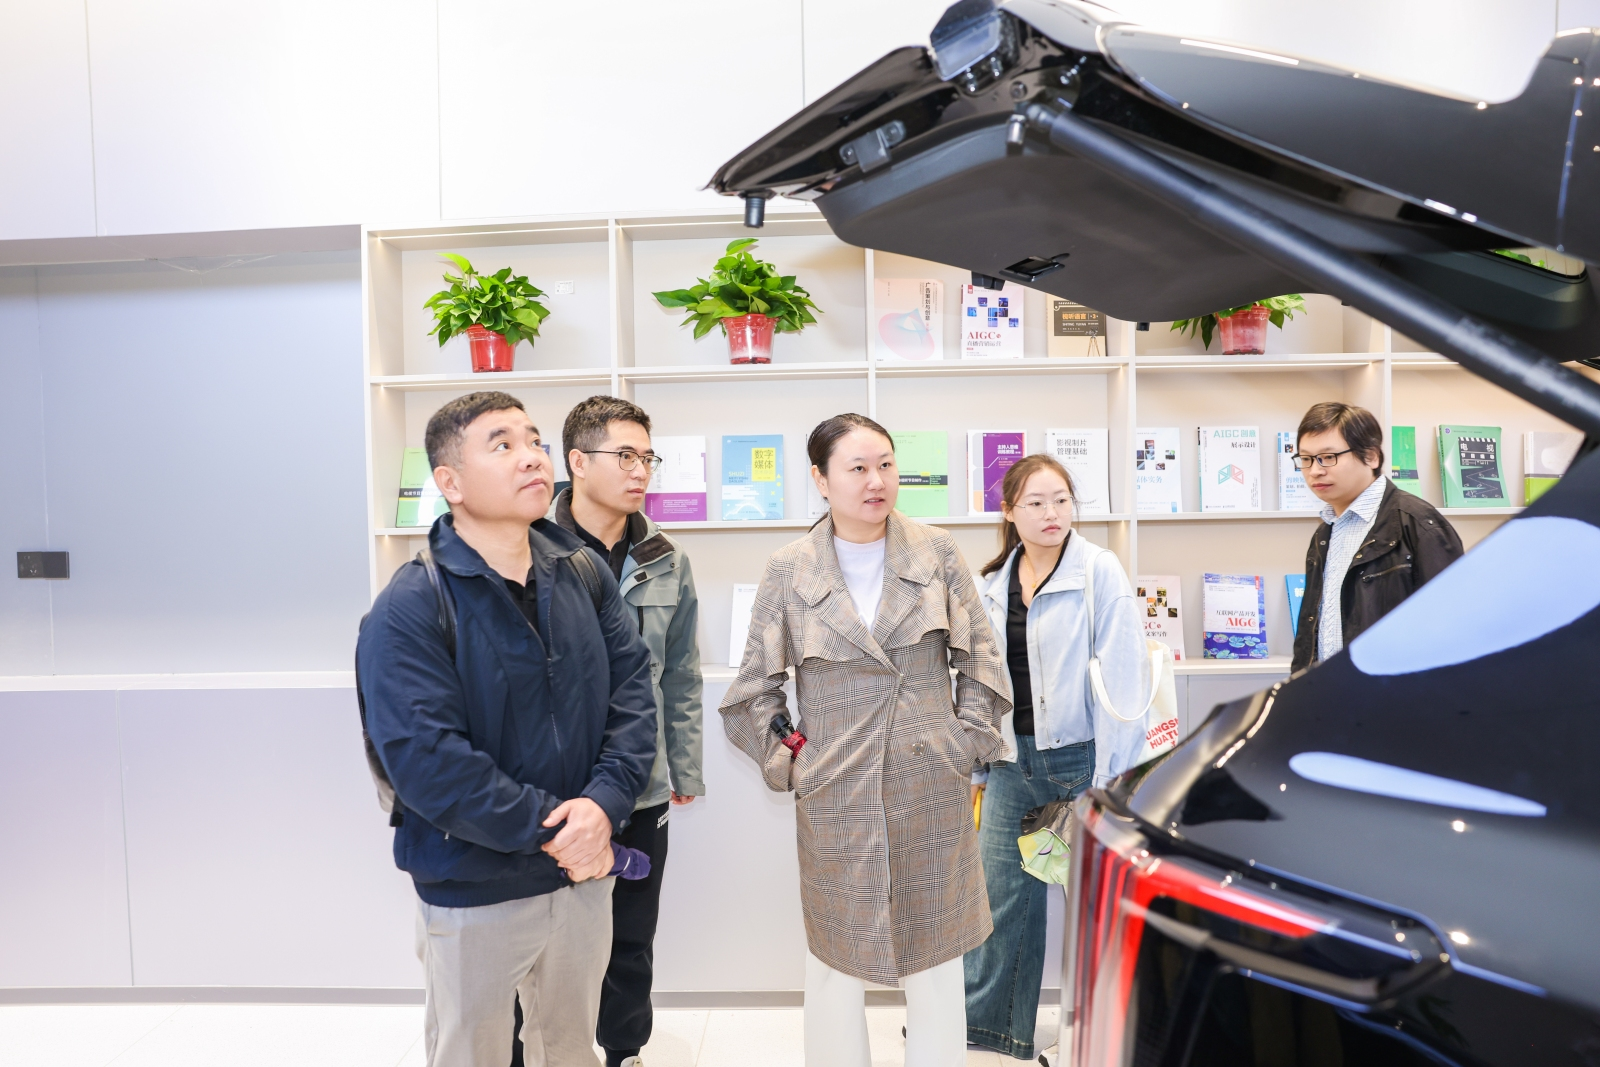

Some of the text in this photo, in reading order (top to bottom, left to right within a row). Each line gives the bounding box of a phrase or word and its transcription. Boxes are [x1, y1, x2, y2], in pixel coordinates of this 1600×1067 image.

[967, 331, 996, 340] AIGC
[1056, 438, 1087, 447] 影视制片
[1460, 442, 1495, 453] 电视
[754, 449, 774, 459] 数字
[1056, 447, 1088, 455] 管理基础
[754, 459, 774, 469] 媒体
[1225, 617, 1257, 627] AIGC
